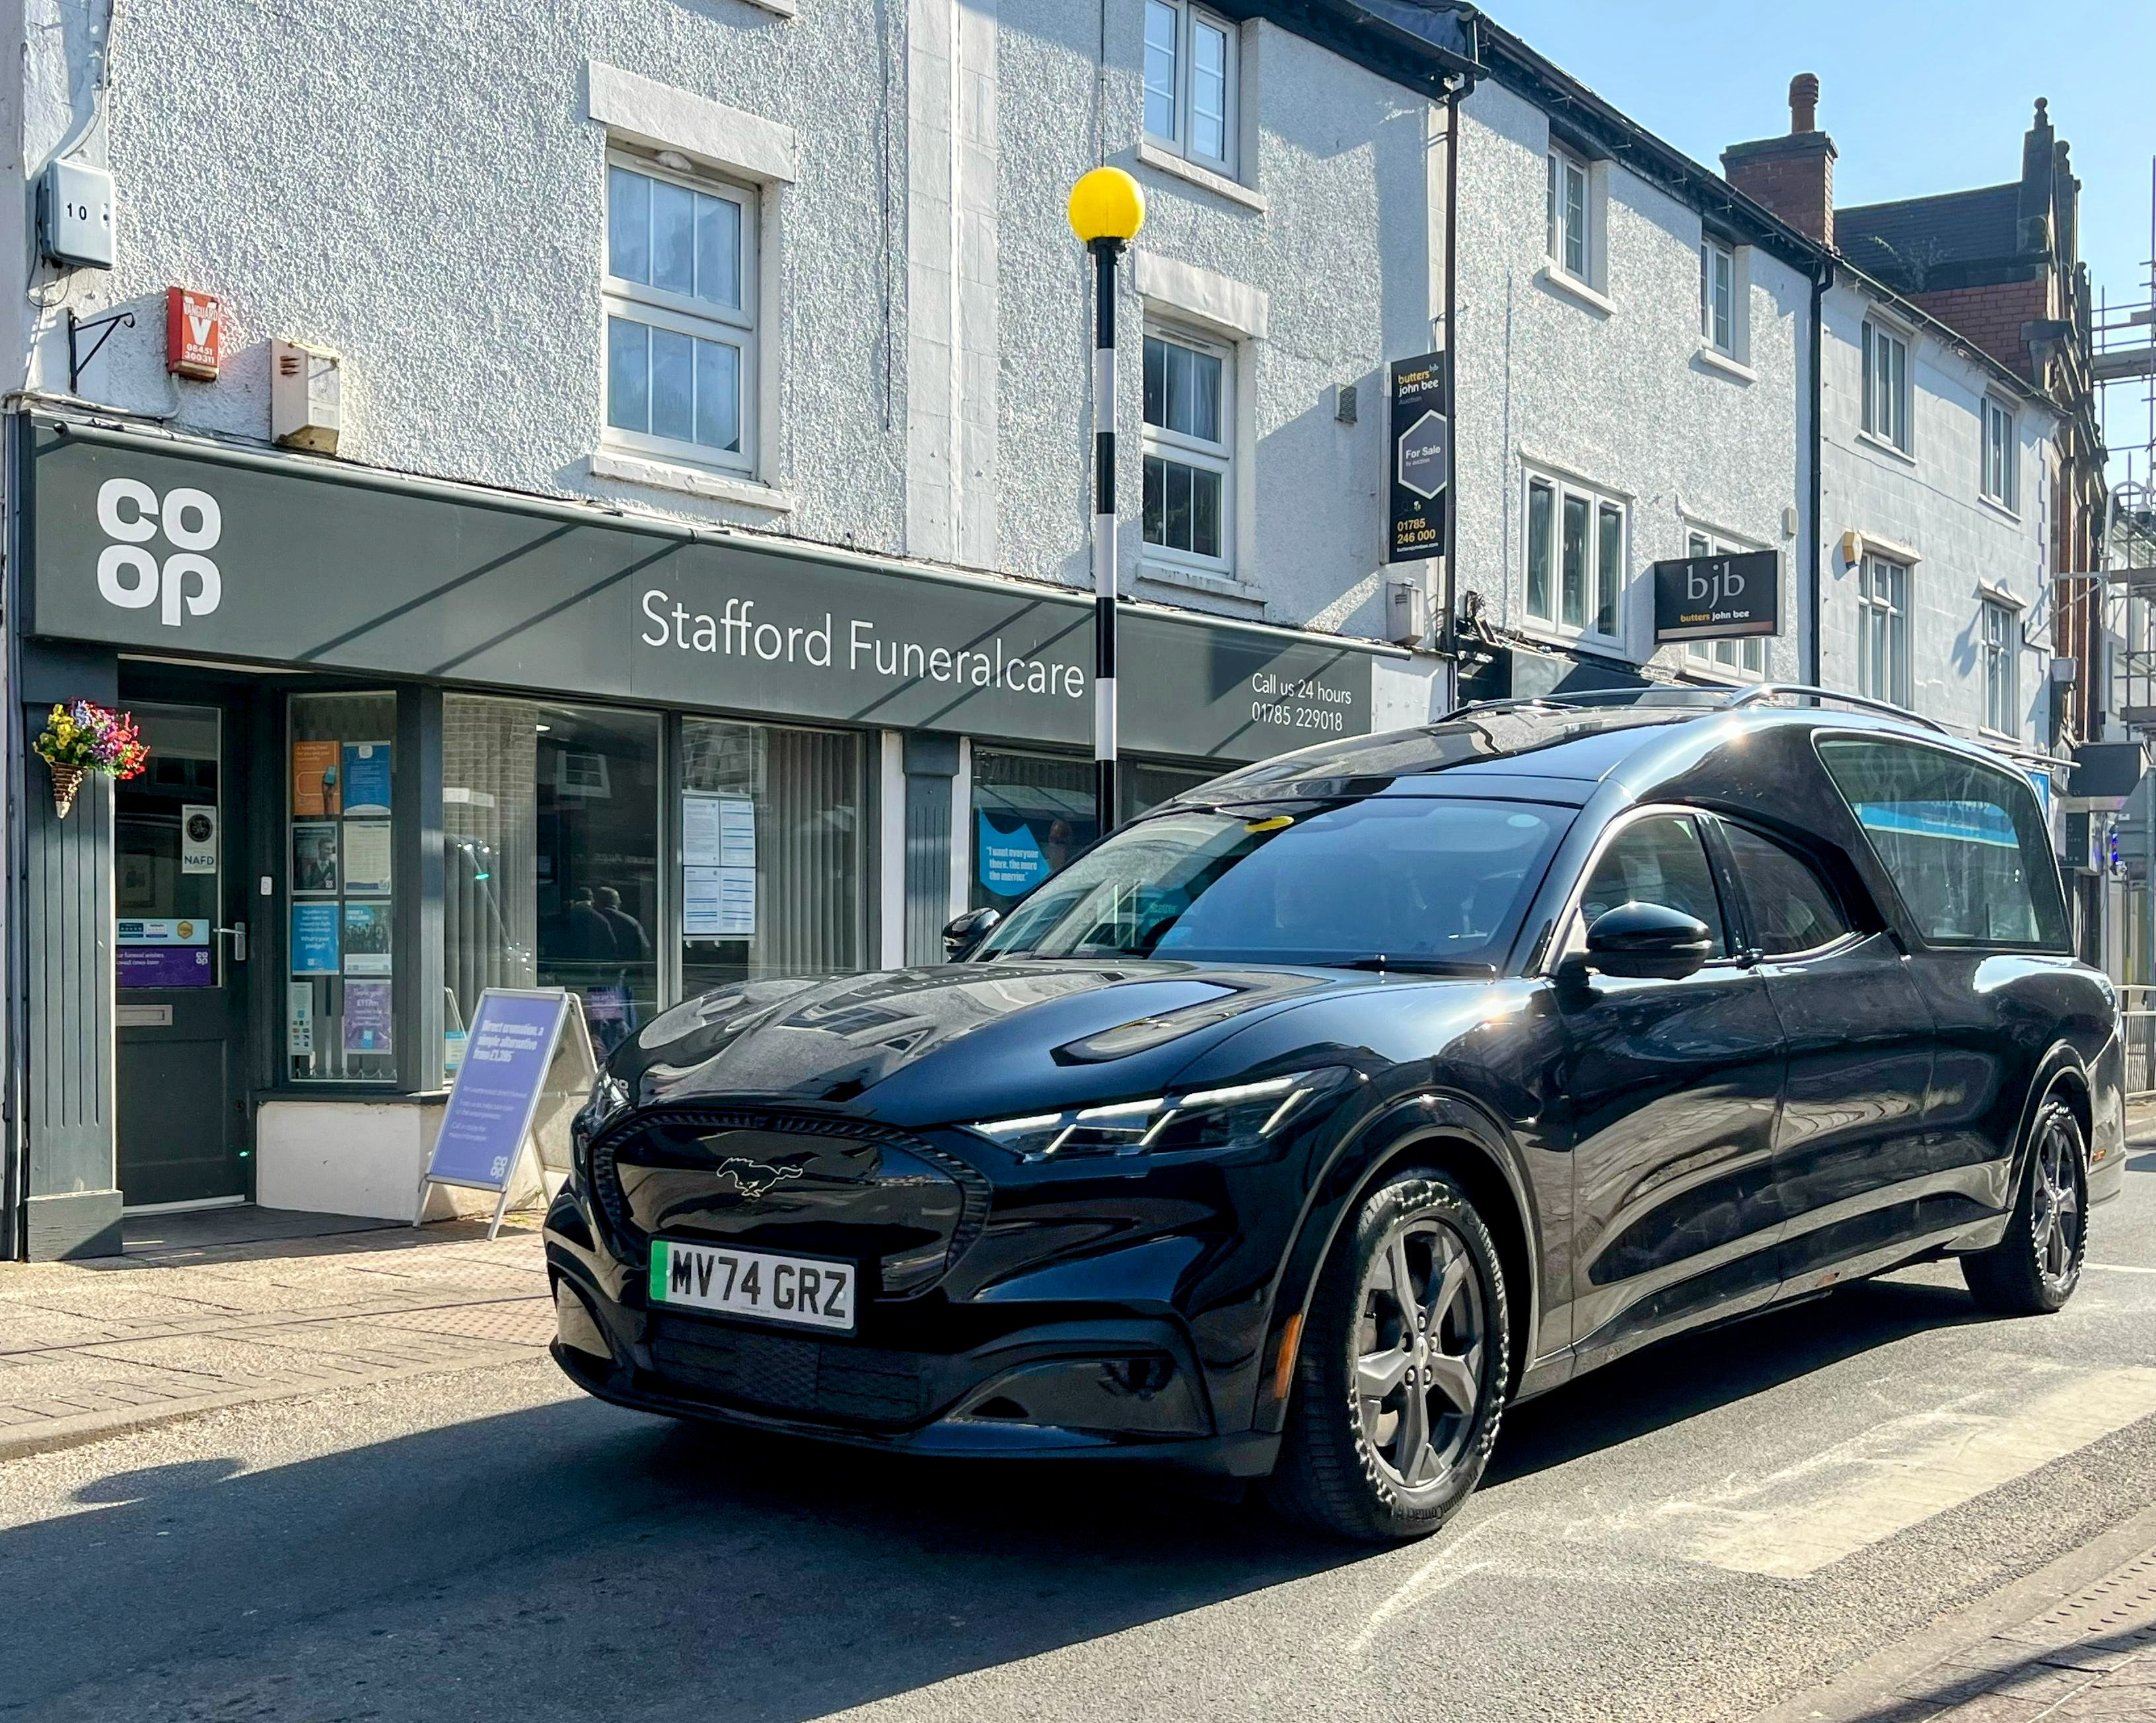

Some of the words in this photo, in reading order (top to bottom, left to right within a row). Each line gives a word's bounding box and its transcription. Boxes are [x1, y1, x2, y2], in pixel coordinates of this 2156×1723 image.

[67, 202, 87, 221] 10
[183, 302, 217, 322] VANGUARD
[186, 343, 213, 355] 08451
[185, 351, 215, 365] 300311
[1398, 370, 1430, 385] butters
[1398, 385, 1419, 398] john
[1421, 379, 1439, 390] bee
[1406, 449, 1420, 459] For
[1422, 445, 1441, 456] Sale
[1397, 518, 1426, 532] 01785
[1397, 532, 1415, 544] 246
[1418, 529, 1436, 541] 000
[1686, 561, 1745, 609] bjb
[1680, 614, 1711, 622] butters
[1711, 611, 1731, 622] john
[1733, 610, 1750, 618] bee
[641, 589, 832, 667] Stafford
[849, 620, 1085, 699] Funeralcare
[1252, 673, 1276, 694] Call
[1280, 682, 1295, 697] us
[1297, 678, 1314, 700] 24
[1317, 680, 1351, 704] hours
[1252, 702, 1291, 725] 01785
[1296, 707, 1343, 731] 229018
[184, 856, 215, 865] NAFD
[992, 848, 1008, 857] want
[1009, 849, 1038, 860] everyone
[1009, 859, 1020, 869] the
[1021, 862, 1037, 870] more
[989, 870, 1000, 881] the
[671, 1249, 761, 1305] MV74
[773, 1264, 847, 1318] GRZ
